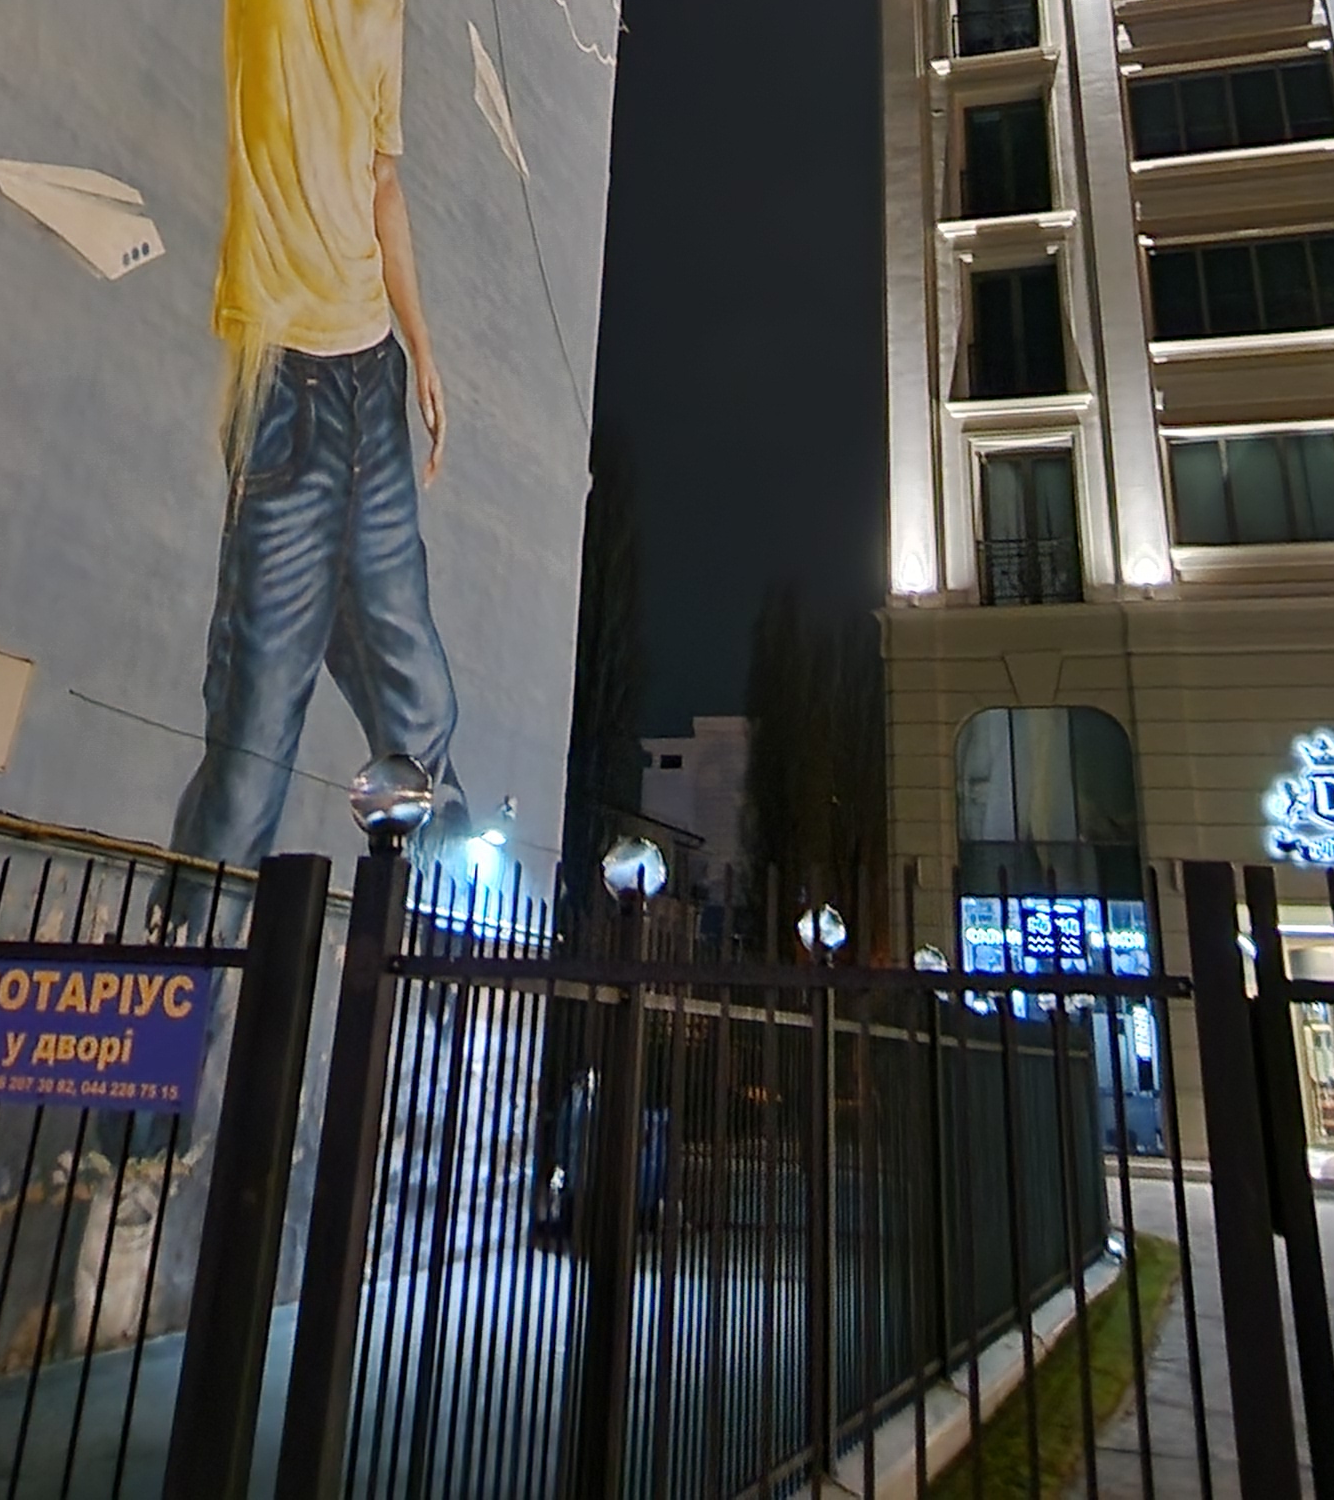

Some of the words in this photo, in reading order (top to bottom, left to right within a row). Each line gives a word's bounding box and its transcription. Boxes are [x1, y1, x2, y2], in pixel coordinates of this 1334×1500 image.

[0, 1031, 27, 1067] у
[31, 1027, 134, 1072] дворі
[160, 1084, 179, 1101] 15
